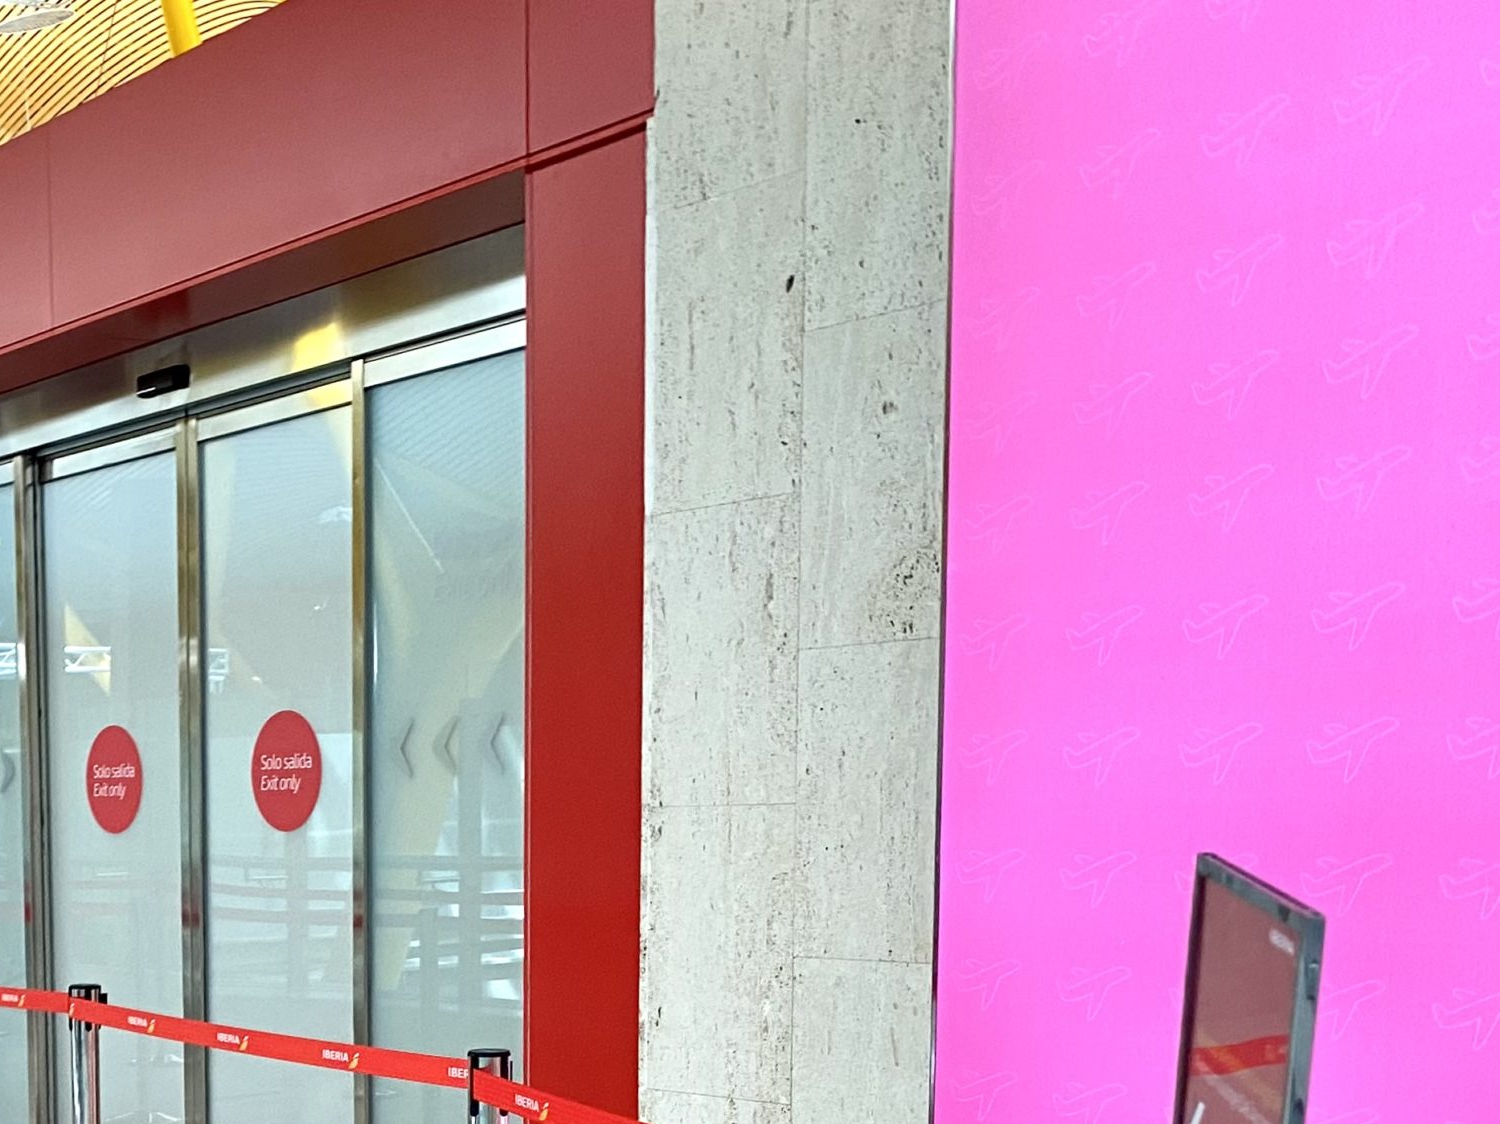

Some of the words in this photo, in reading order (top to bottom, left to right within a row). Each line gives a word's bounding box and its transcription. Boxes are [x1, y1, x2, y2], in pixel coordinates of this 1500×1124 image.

[260, 754, 282, 770] Solo
[283, 752, 313, 769] salida
[93, 764, 110, 778] Solo
[261, 774, 279, 791] Exit
[279, 773, 301, 794] only
[217, 1033, 240, 1045] IBERIA
[322, 1050, 349, 1063] IBERIA
[515, 1094, 540, 1113] IBERIA
